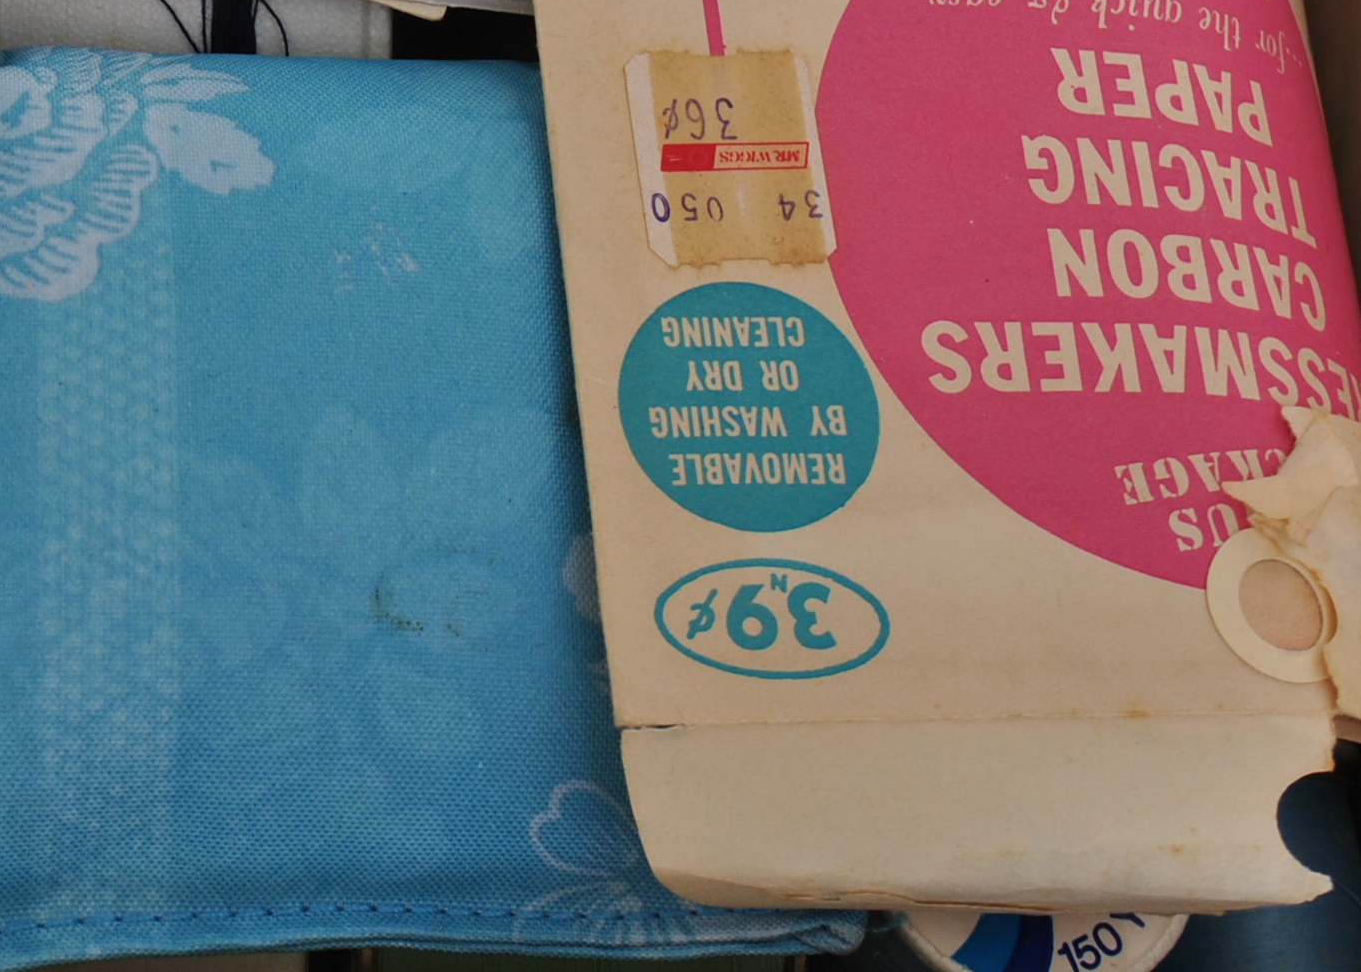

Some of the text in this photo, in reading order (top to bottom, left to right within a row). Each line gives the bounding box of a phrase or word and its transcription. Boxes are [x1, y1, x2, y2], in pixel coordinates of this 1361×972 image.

[1198, 5, 1241, 51] the
[1050, 48, 1274, 147] PAPER
[1021, 134, 1317, 249] TRACING
[1046, 228, 1326, 332] CARBON
[661, 316, 806, 348] CLEANING
[685, 360, 800, 392] OR DRY
[648, 405, 848, 439] BY WASHING
[668, 452, 848, 487] REMOVABLE
[1057, 921, 1124, 972] 150
